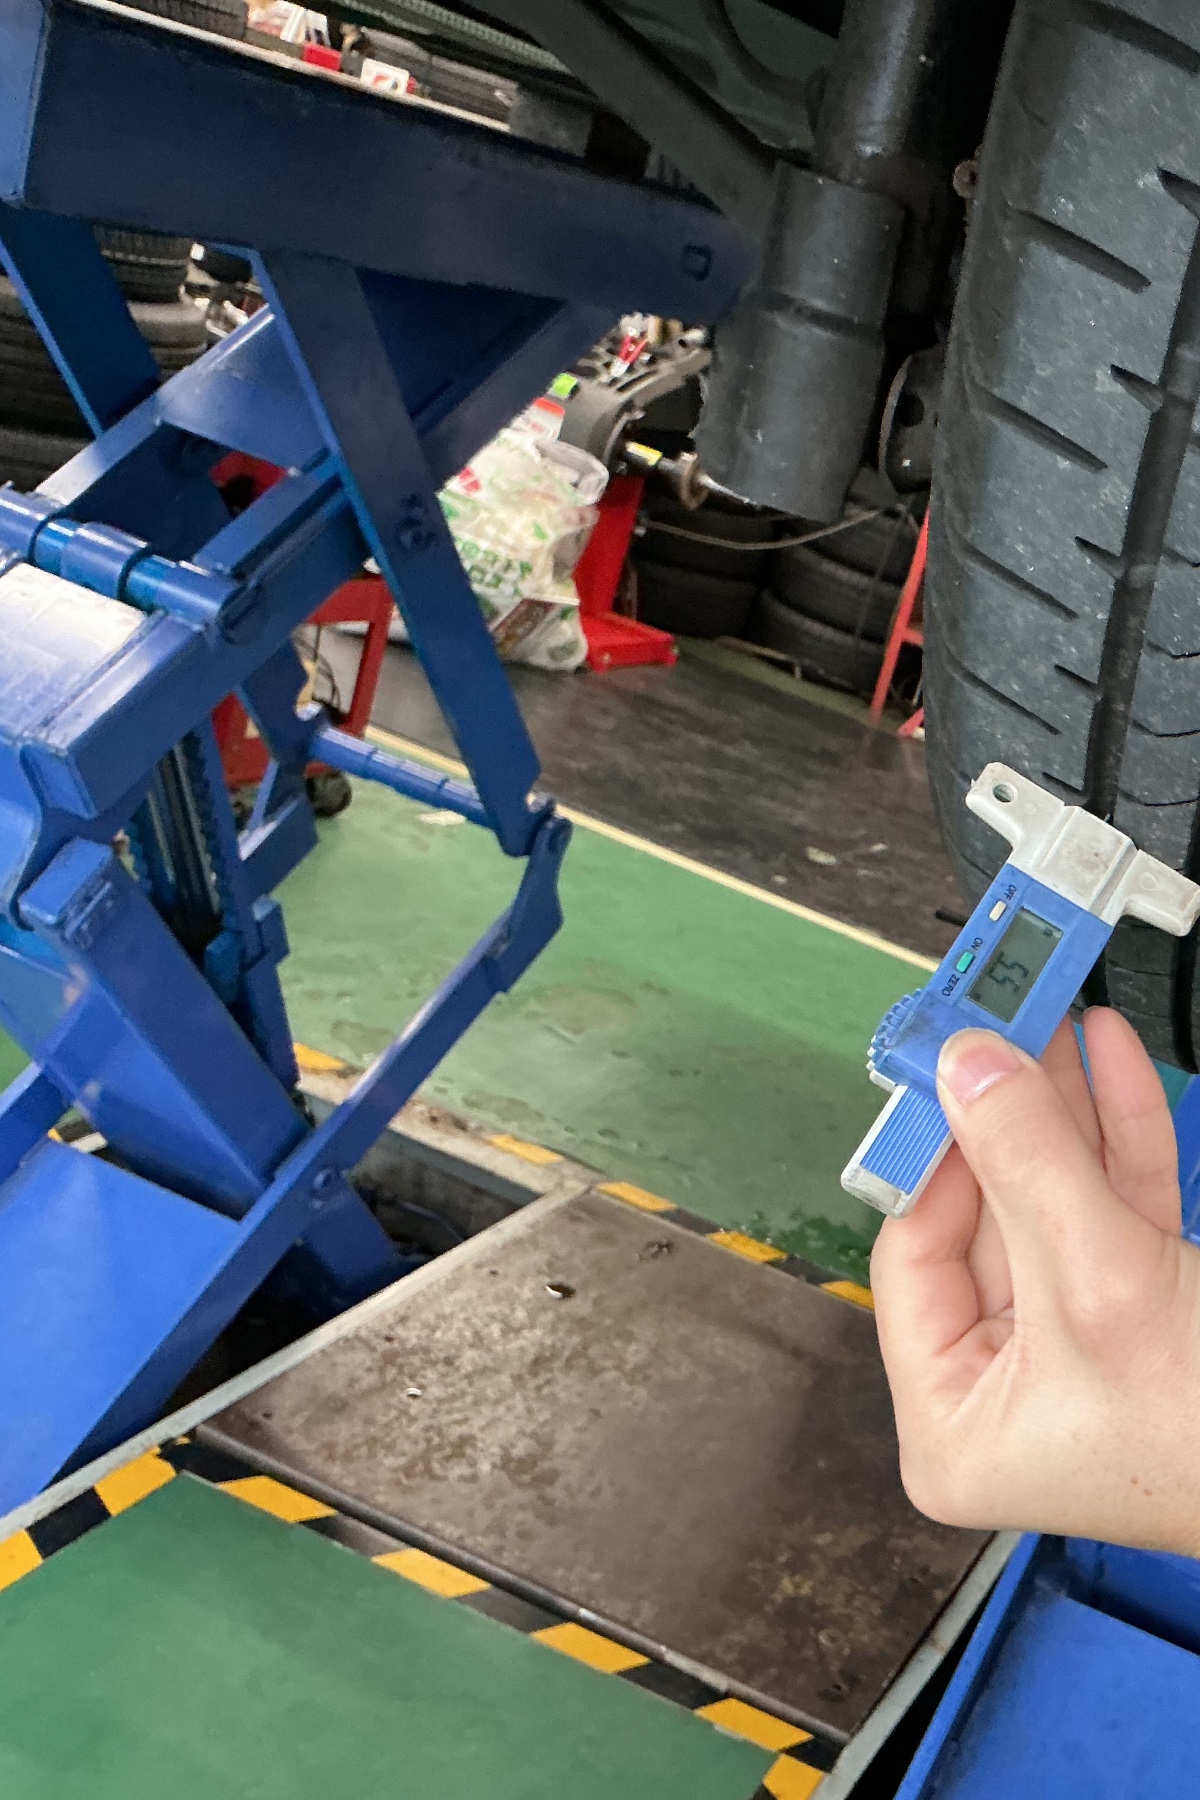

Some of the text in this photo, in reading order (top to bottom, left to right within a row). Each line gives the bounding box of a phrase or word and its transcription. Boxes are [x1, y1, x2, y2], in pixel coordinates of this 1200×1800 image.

[1003, 884, 1017, 900] OFF
[941, 937, 983, 996] ON ZERO
